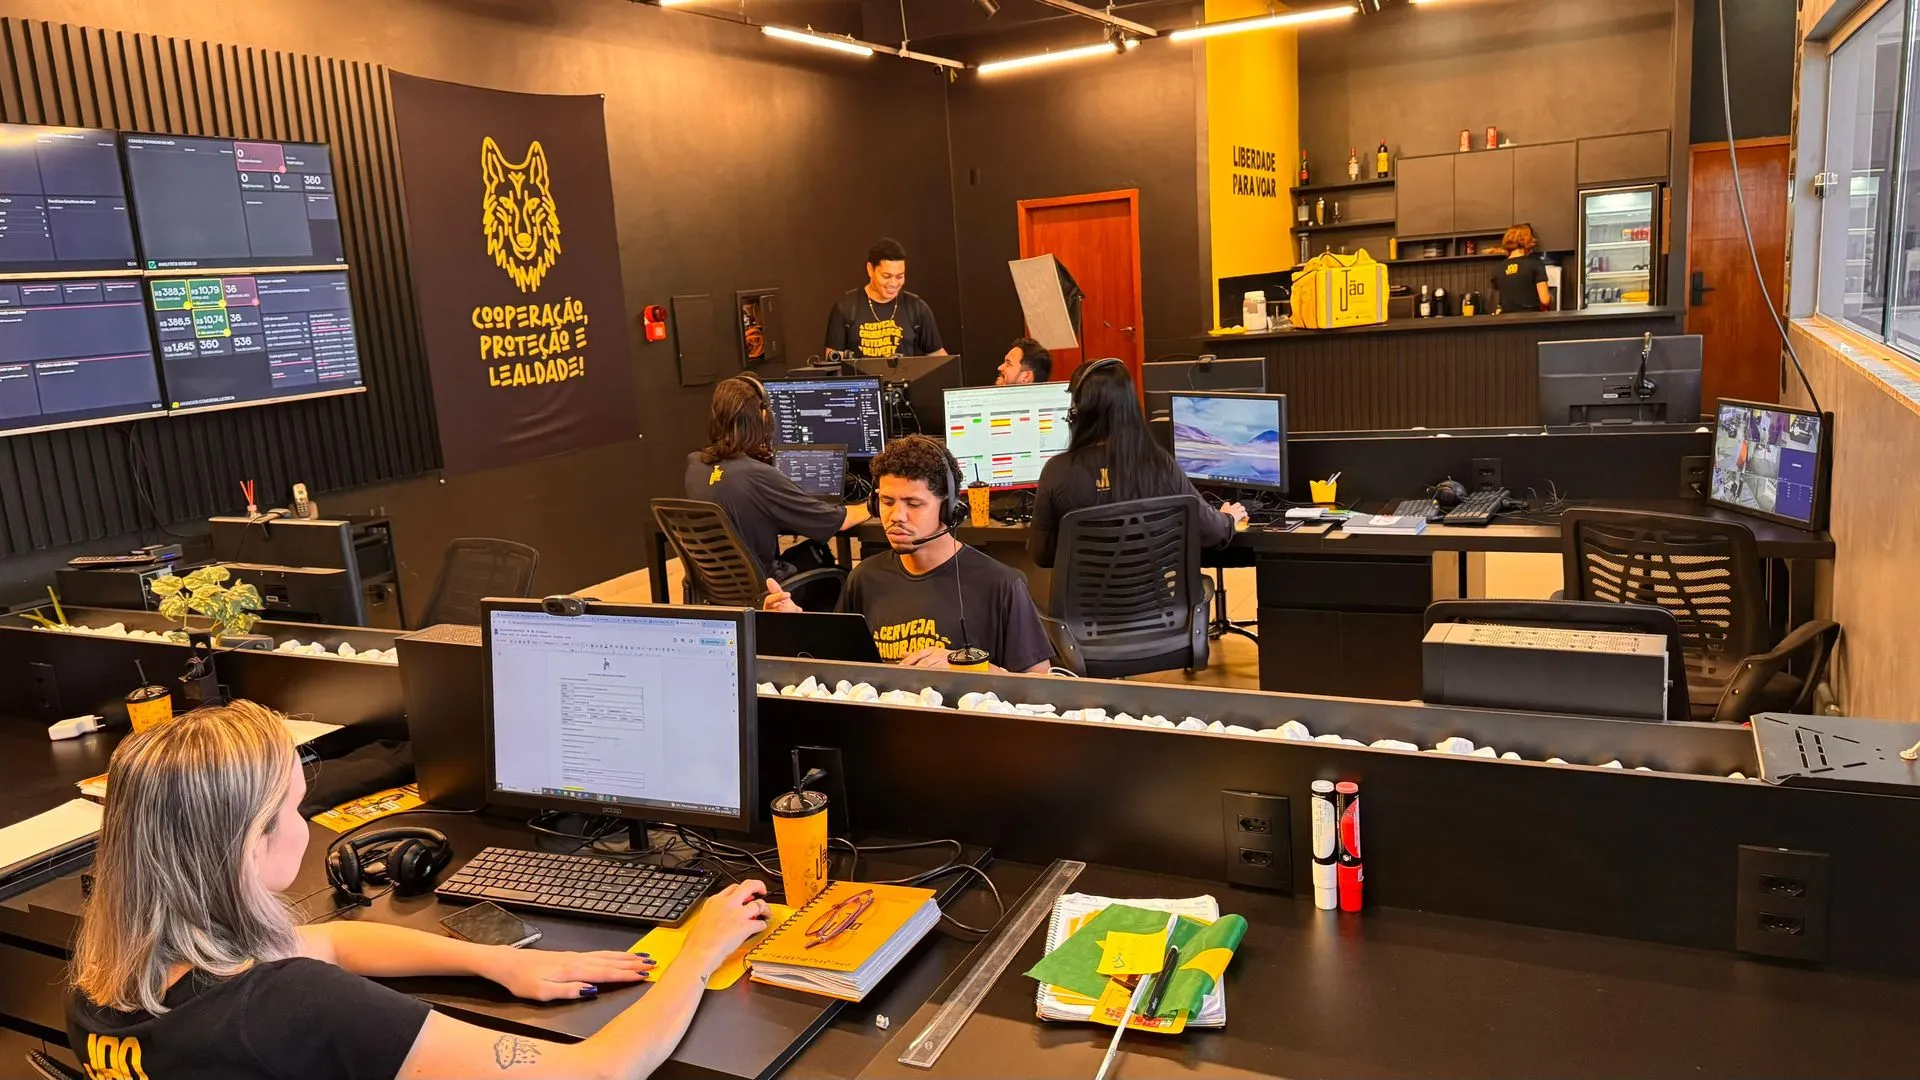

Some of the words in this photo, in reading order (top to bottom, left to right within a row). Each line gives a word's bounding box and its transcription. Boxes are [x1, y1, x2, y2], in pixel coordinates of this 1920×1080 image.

[1233, 145, 1276, 172] LIBERDADE
[1232, 173, 1255, 196] PARA
[1256, 176, 1276, 198] VOAR
[1340, 269, 1364, 312] Jão
[472, 296, 588, 330] COOPERAÇÃO,
[199, 339, 219, 349] 360
[480, 327, 570, 360] PROTEÇÃO
[575, 327, 587, 348] E
[489, 356, 585, 387] LEALDADE!
[880, 618, 940, 641] CERVEJA,
[875, 636, 945, 659] HURRASC
